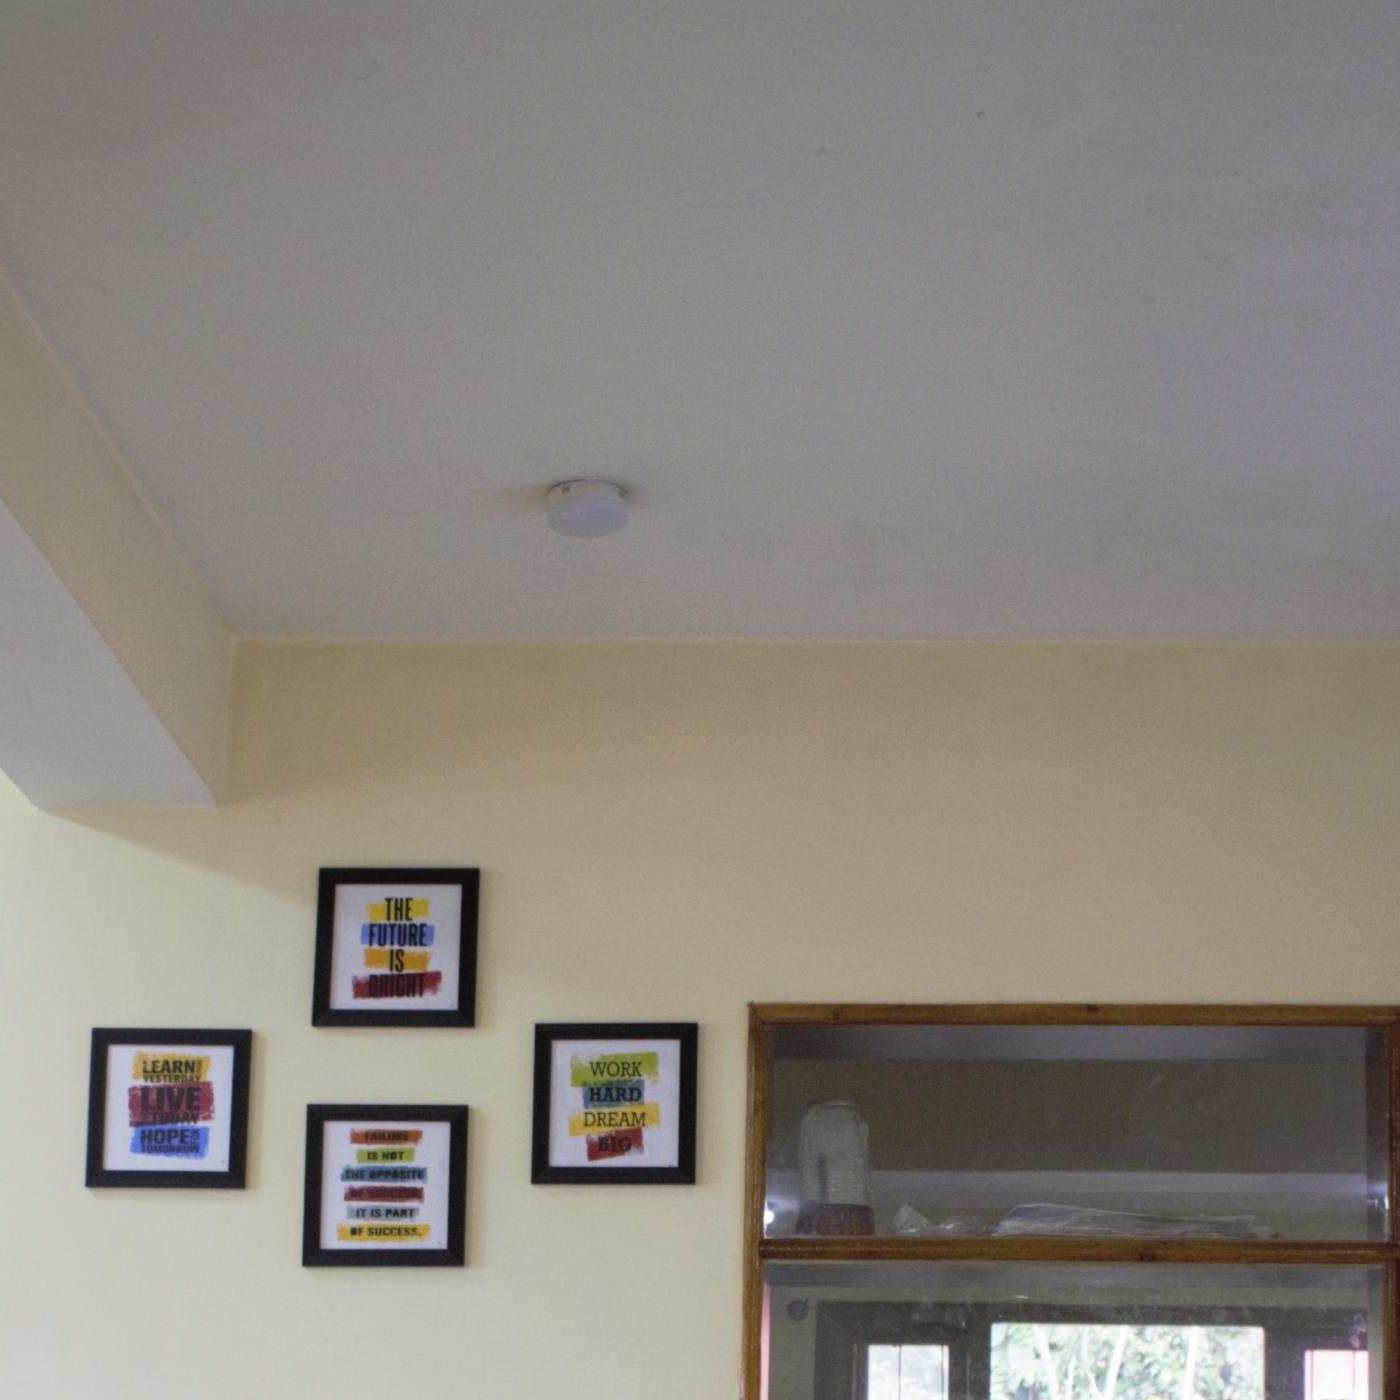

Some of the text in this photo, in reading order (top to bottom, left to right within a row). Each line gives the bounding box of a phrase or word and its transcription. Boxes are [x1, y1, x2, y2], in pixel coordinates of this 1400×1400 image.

[384, 897, 413, 921] THE
[368, 923, 427, 947] FUTURE
[389, 949, 404, 973] IS
[369, 974, 425, 998] BRIGHT
[142, 1060, 195, 1073] LEARN
[590, 1061, 642, 1077] WORK
[143, 1074, 201, 1083] YESTERDAY
[141, 1086, 201, 1111] LIVE
[589, 1087, 642, 1102] HARD
[584, 1111, 647, 1127] DREAM
[140, 1129, 189, 1144] HOPE
[598, 1136, 633, 1152] BIG
[141, 1144, 201, 1154] TOMORROW
[367, 1151, 404, 1160] IS NOT
[345, 1169, 425, 1180] THE OPPOSITE
[356, 1208, 415, 1218] IT IS PART
[350, 1227, 363, 1236] OF
